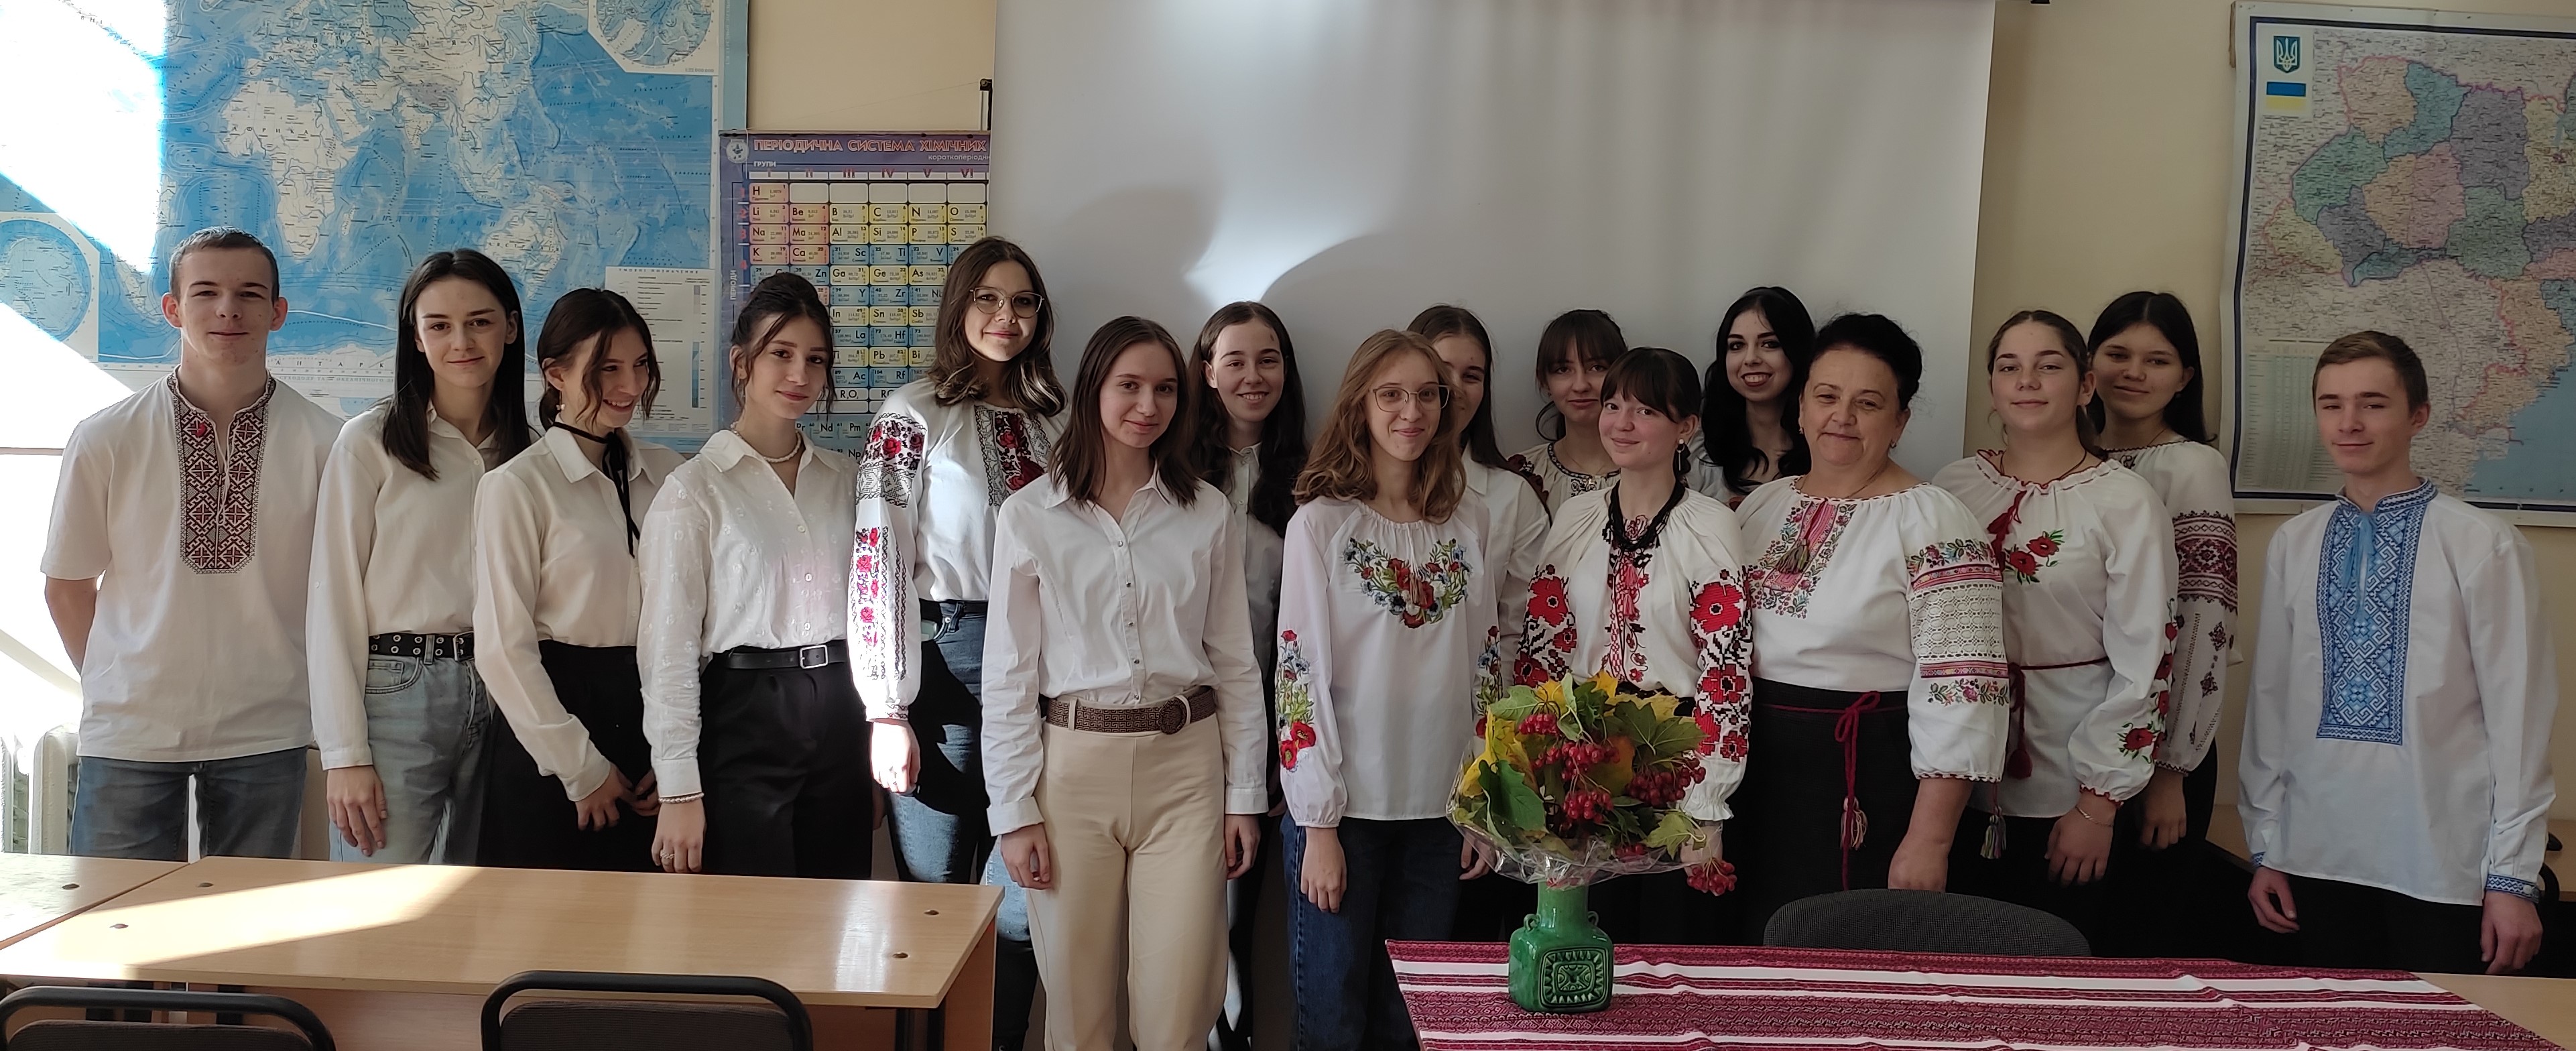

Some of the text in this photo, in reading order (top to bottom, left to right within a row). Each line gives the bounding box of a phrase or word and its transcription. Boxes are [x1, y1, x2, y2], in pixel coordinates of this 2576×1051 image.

[753, 139, 987, 153] ПЕРІОДИЧНА СИСТЕМА ХІМІЧНИХ
[843, 168, 855, 178] III
[881, 168, 895, 178] IV
[922, 168, 932, 178] V
[960, 168, 973, 178] VI
[753, 186, 760, 196] H
[753, 207, 759, 215] Li
[792, 207, 804, 215] Be
[832, 207, 838, 216] B
[873, 207, 881, 217] C
[912, 207, 920, 217] N
[950, 207, 959, 216] O
[753, 227, 765, 236] Na
[832, 228, 842, 236] Al
[873, 227, 881, 236] Si
[912, 228, 917, 236] P
[950, 227, 957, 236] S
[753, 247, 760, 256] K
[792, 247, 806, 257] Ca
[855, 247, 866, 257] Sc
[898, 248, 906, 257] Ti
[936, 247, 944, 256] V
[815, 269, 827, 277] Zn
[833, 269, 846, 277] Ga
[873, 269, 886, 277] Ge
[912, 269, 924, 277] As
[859, 288, 866, 297] Y
[896, 289, 906, 297] Zr
[833, 309, 841, 318] In
[873, 309, 885, 318] Sn
[912, 309, 924, 318] Sb
[855, 330, 866, 339] La
[895, 330, 906, 339] Hf
[873, 351, 885, 359] Pb
[912, 351, 920, 359] Bi
[853, 371, 866, 380] Ac
[896, 371, 906, 379] Rf
[820, 424, 833, 432] Nd
[849, 423, 861, 431] Pm
[848, 449, 861, 460] Np
